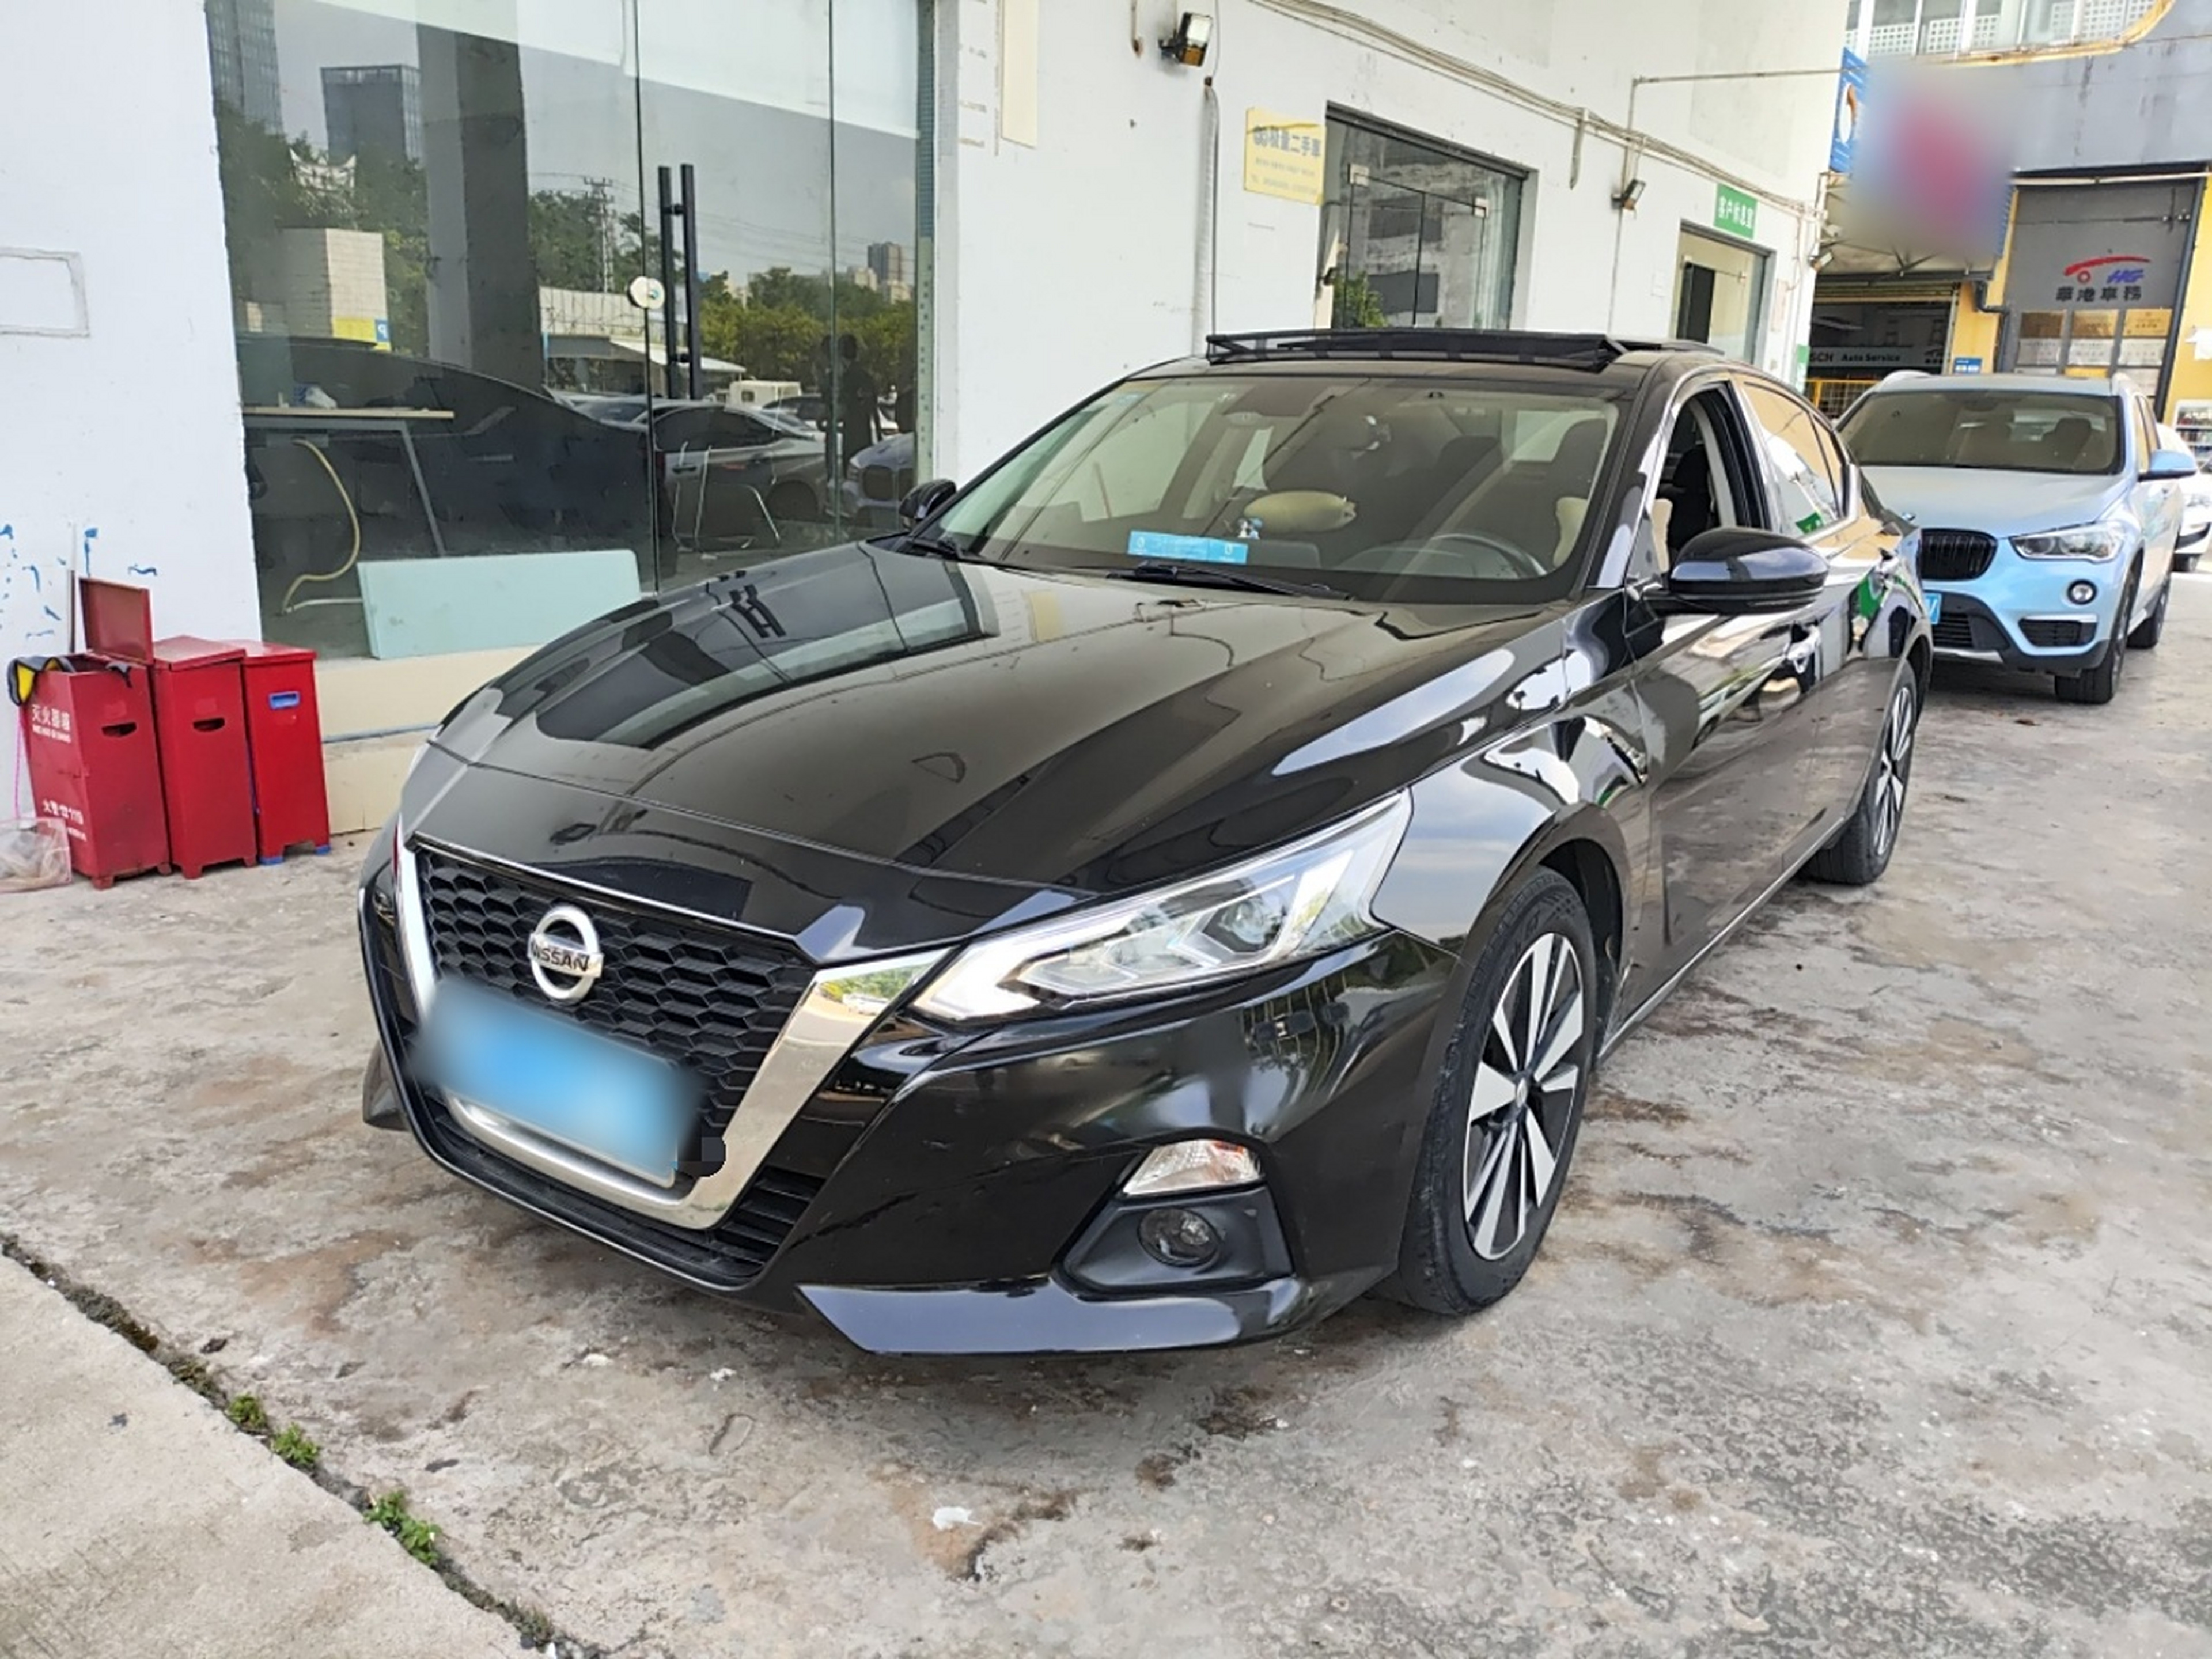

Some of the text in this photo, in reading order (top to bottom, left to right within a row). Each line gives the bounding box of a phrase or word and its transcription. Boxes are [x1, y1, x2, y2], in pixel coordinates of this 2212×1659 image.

[1842, 353, 1863, 362] Auto
[1865, 351, 1900, 362] Service
[530, 938, 590, 972] NISSAN
